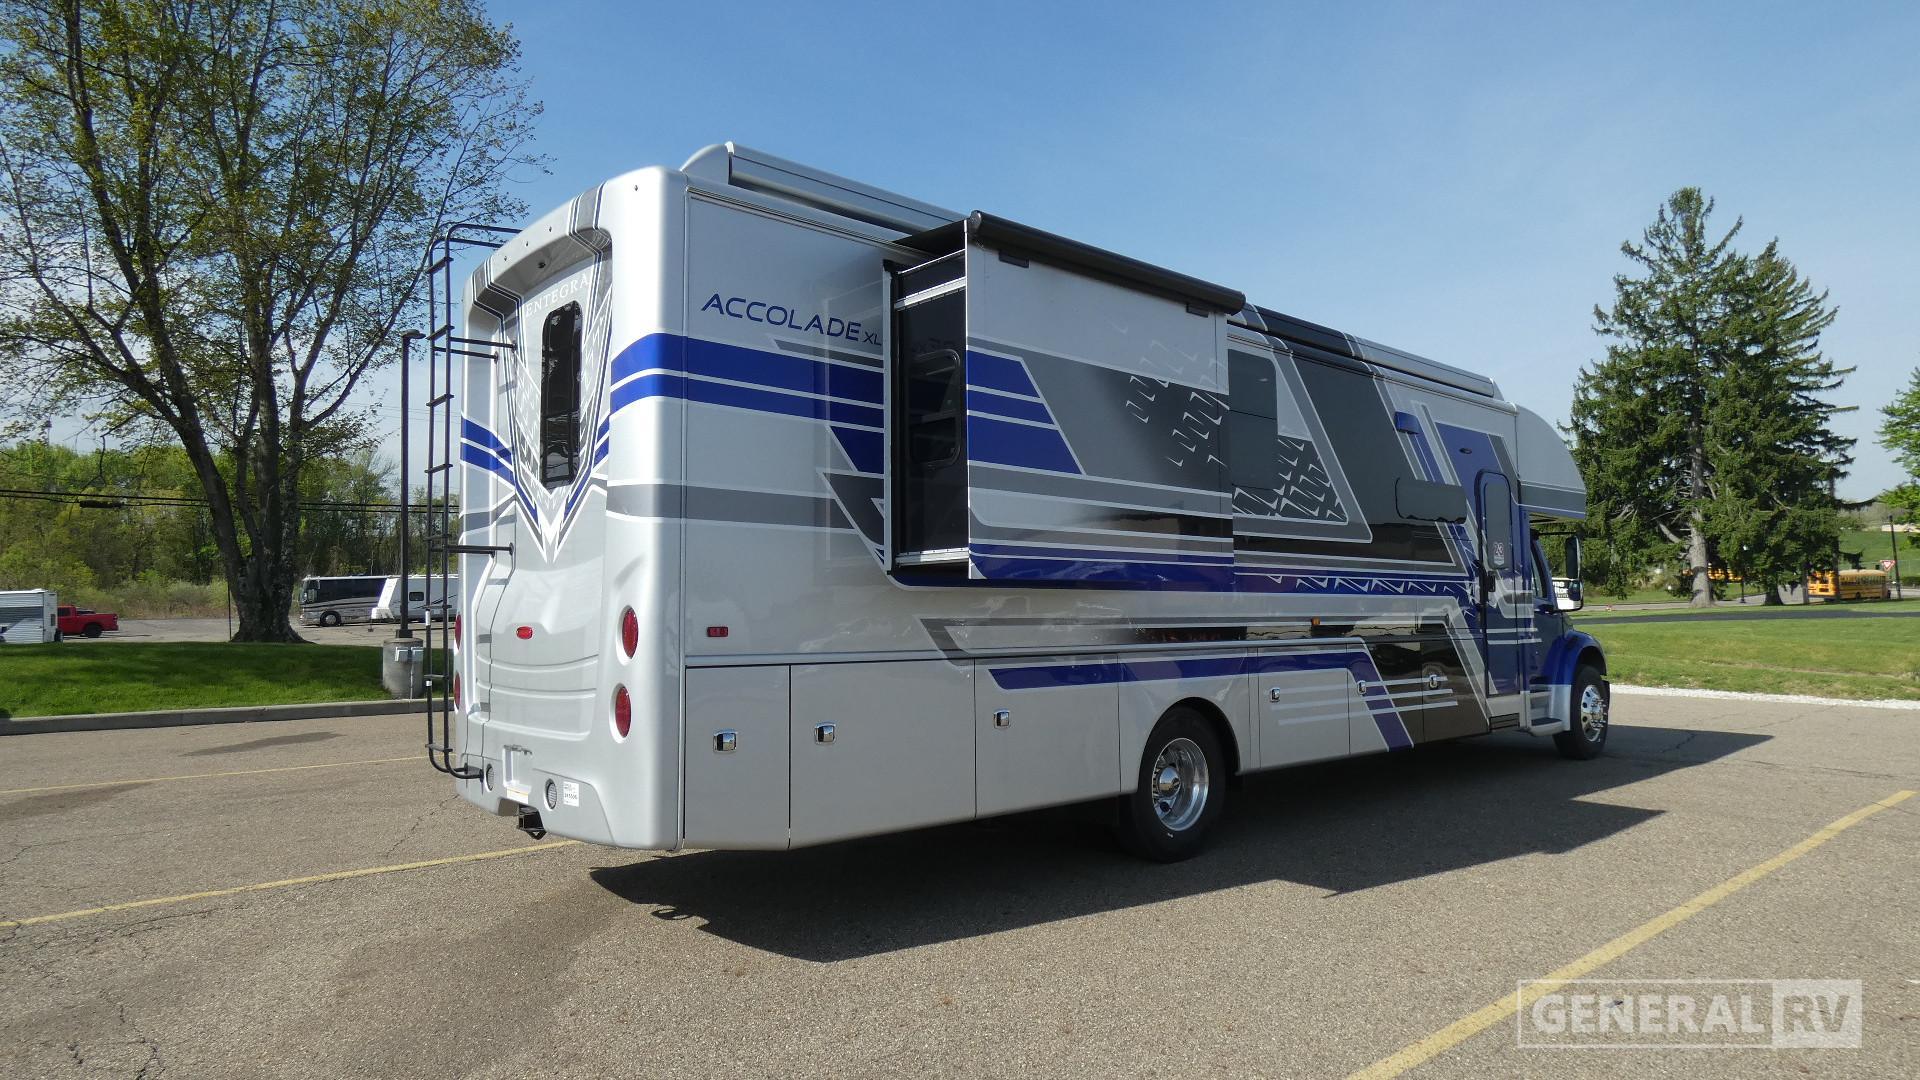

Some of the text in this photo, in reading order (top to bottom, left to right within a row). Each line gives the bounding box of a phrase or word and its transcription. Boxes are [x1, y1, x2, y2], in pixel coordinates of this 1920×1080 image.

[525, 273, 589, 317] ENTEGRA
[701, 293, 882, 346] ACCOLADE XL
